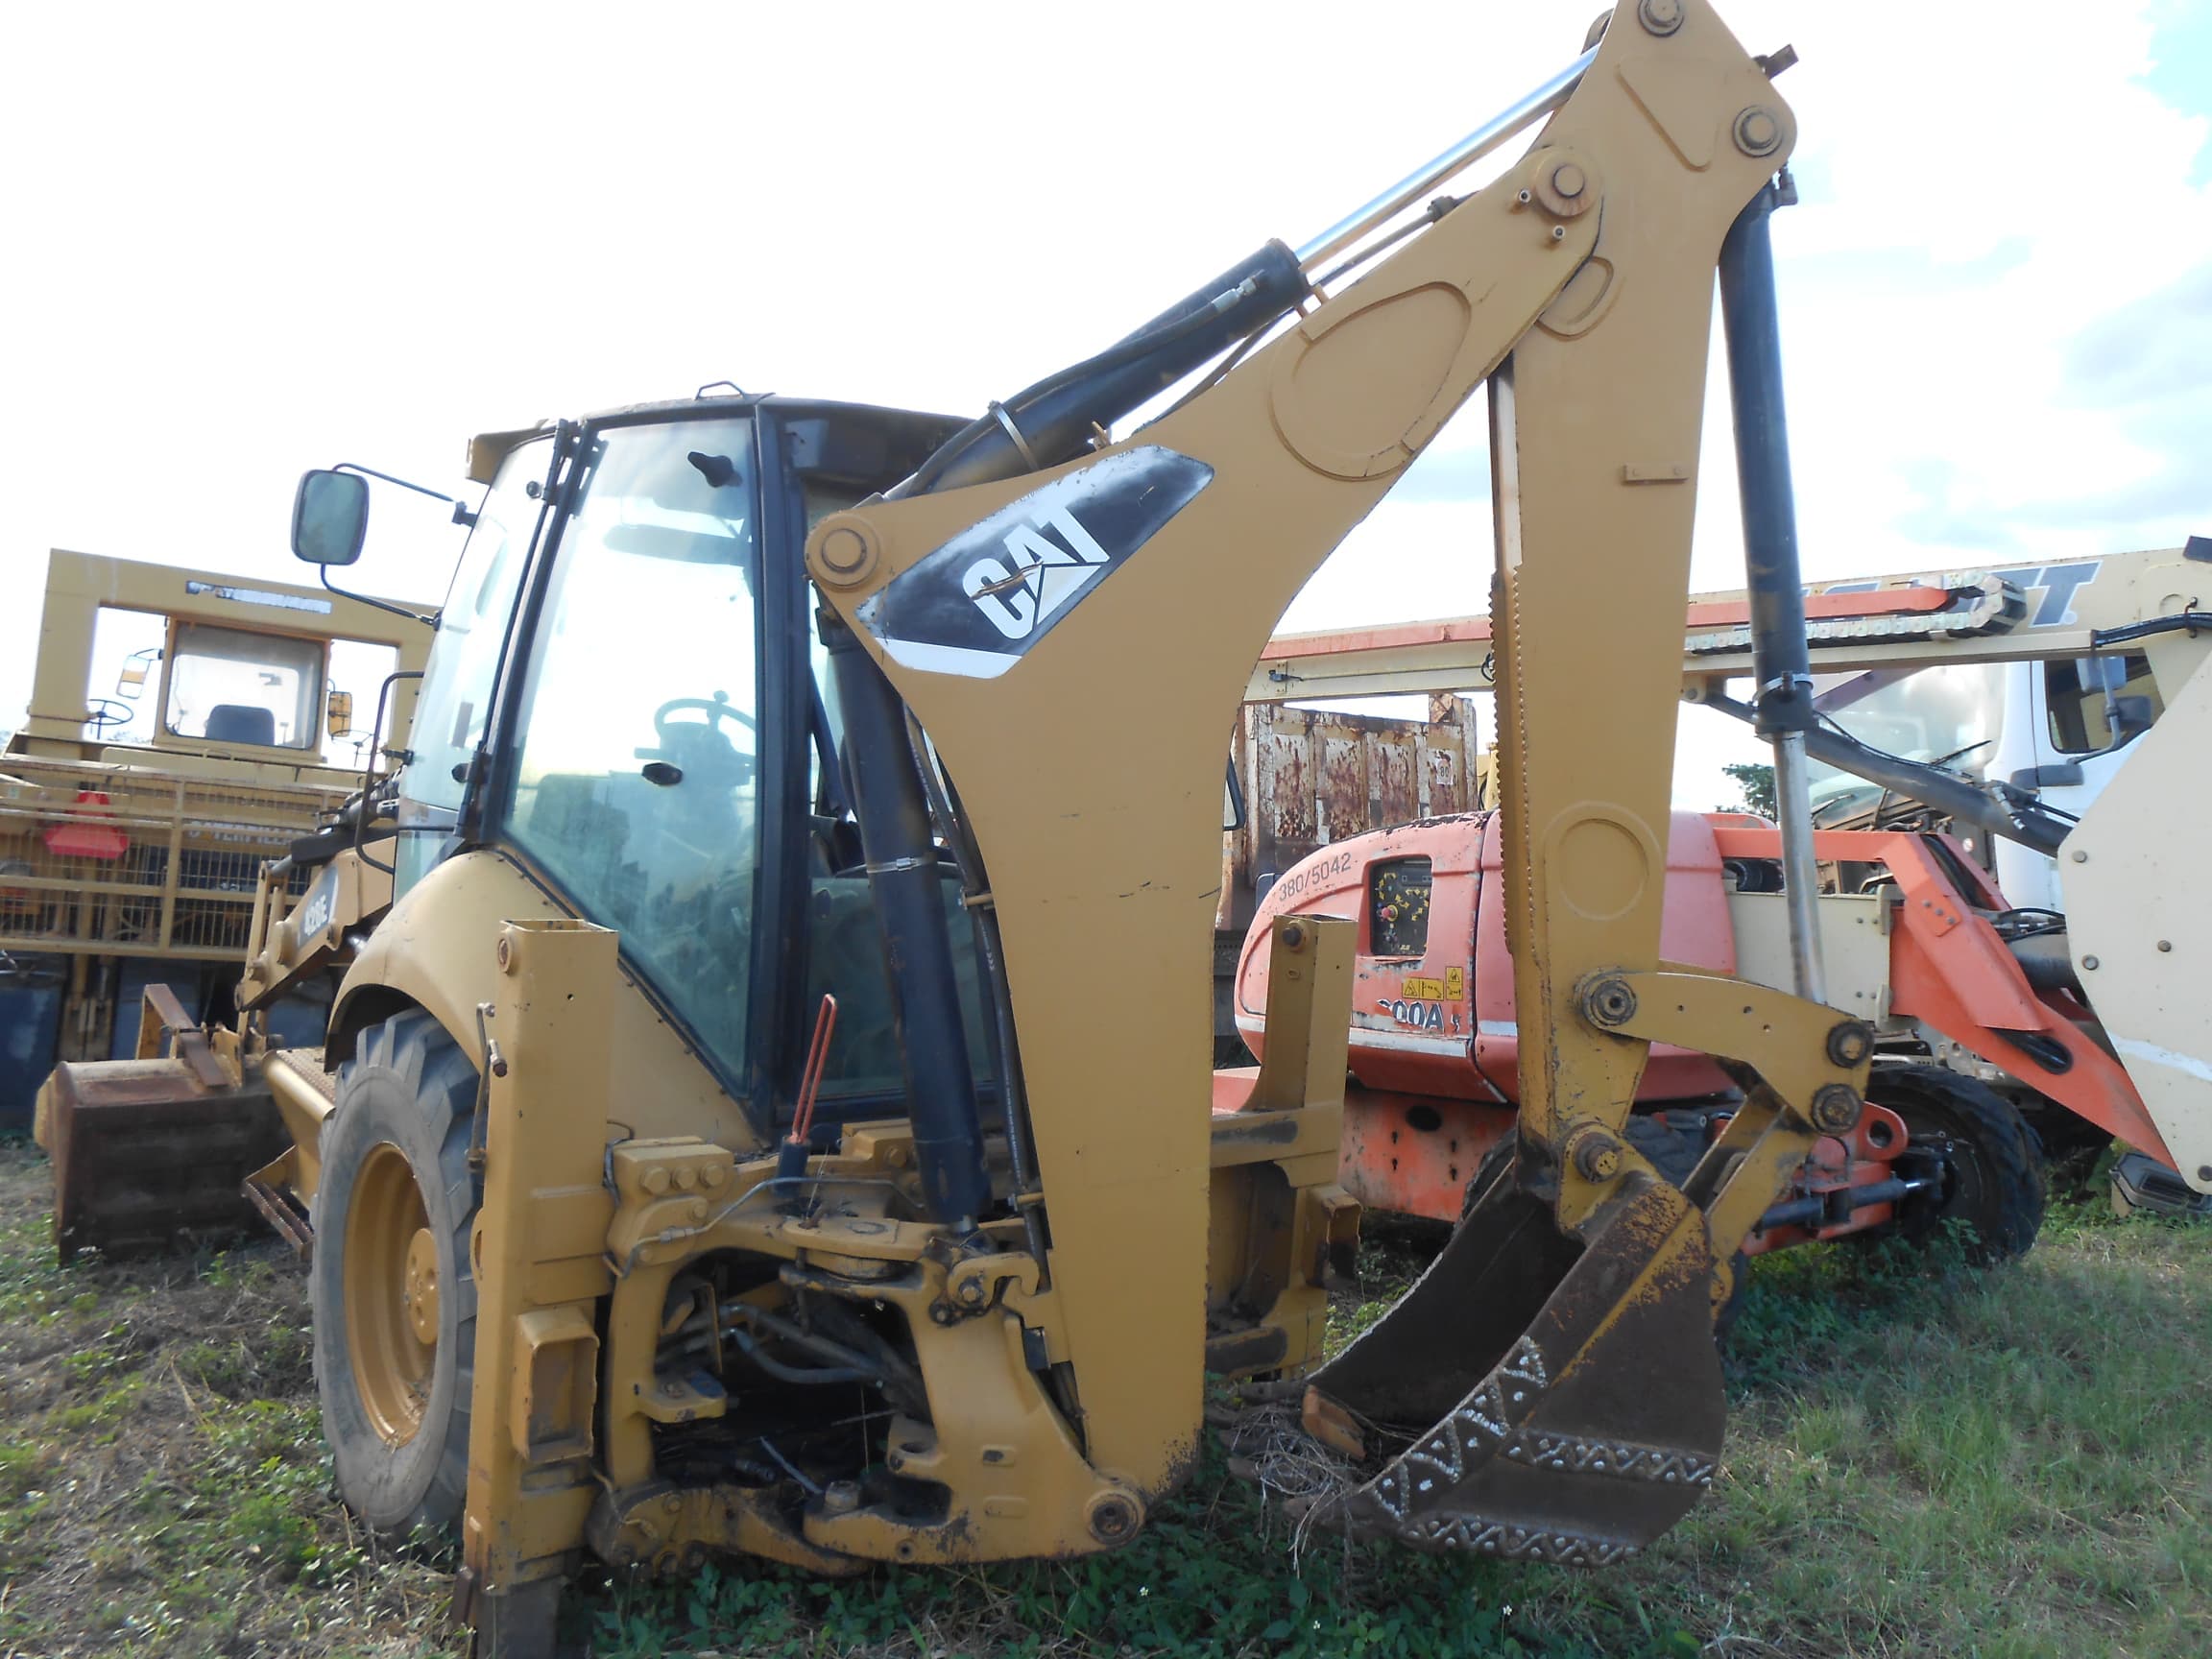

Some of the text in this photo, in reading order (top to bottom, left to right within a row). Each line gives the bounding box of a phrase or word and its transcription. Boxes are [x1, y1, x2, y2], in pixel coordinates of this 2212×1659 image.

[963, 506, 1111, 639] CAT
[1279, 853, 1352, 902] 380/5042
[1376, 999, 1460, 1033] 00A
